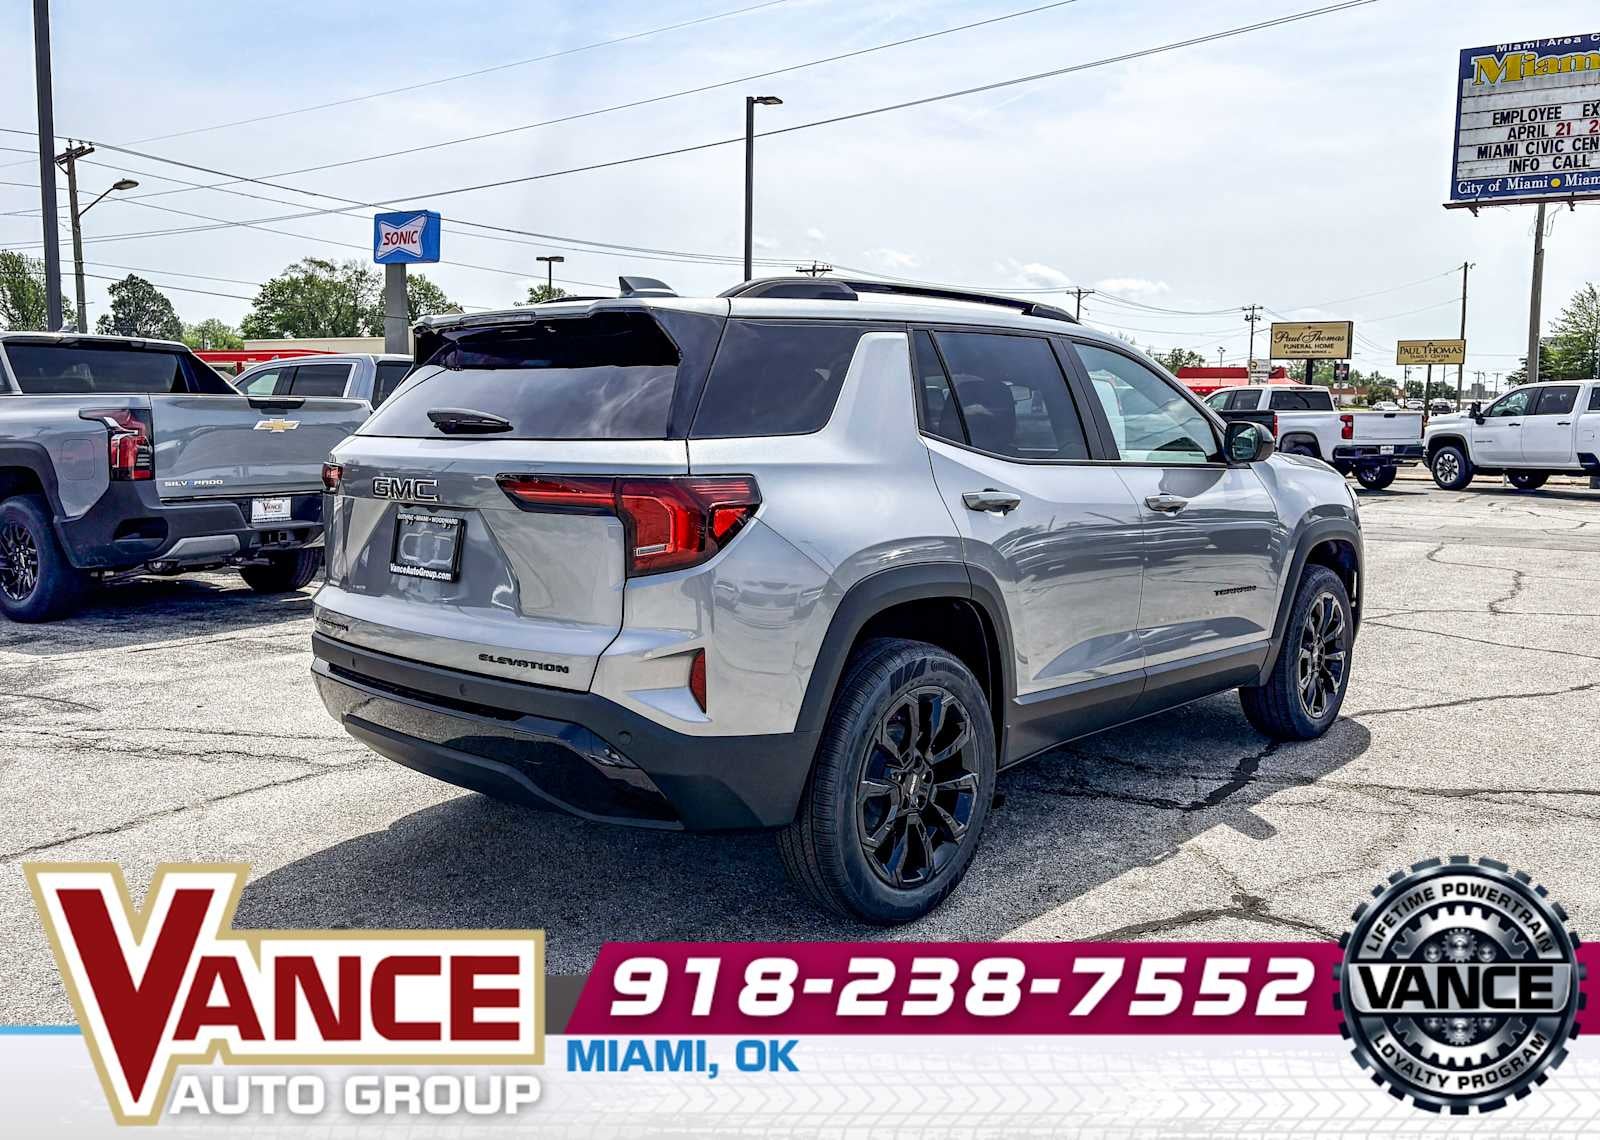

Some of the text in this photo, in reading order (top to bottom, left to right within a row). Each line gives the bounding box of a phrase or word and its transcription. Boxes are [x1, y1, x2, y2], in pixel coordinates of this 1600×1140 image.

[1496, 40, 1541, 53] Miami
[1547, 36, 1582, 47] Area
[1492, 106, 1562, 126] EMPLOYEE
[1507, 119, 1600, 141] APRIL 21 2
[1477, 136, 1600, 160] MIAMI CIVIC CEN
[1508, 153, 1591, 173] INFO CALL
[1457, 181, 1483, 197] City
[1488, 178, 1502, 192] of
[1505, 175, 1549, 191] Miami
[382, 230, 419, 246] SONIC
[1274, 330, 1345, 344] Paul Thomas
[1399, 345, 1463, 355] PAUL THOMAS
[372, 476, 439, 502] GMC
[390, 562, 452, 581] VanceAutoGroup.com
[478, 653, 569, 675] ELEVATION
